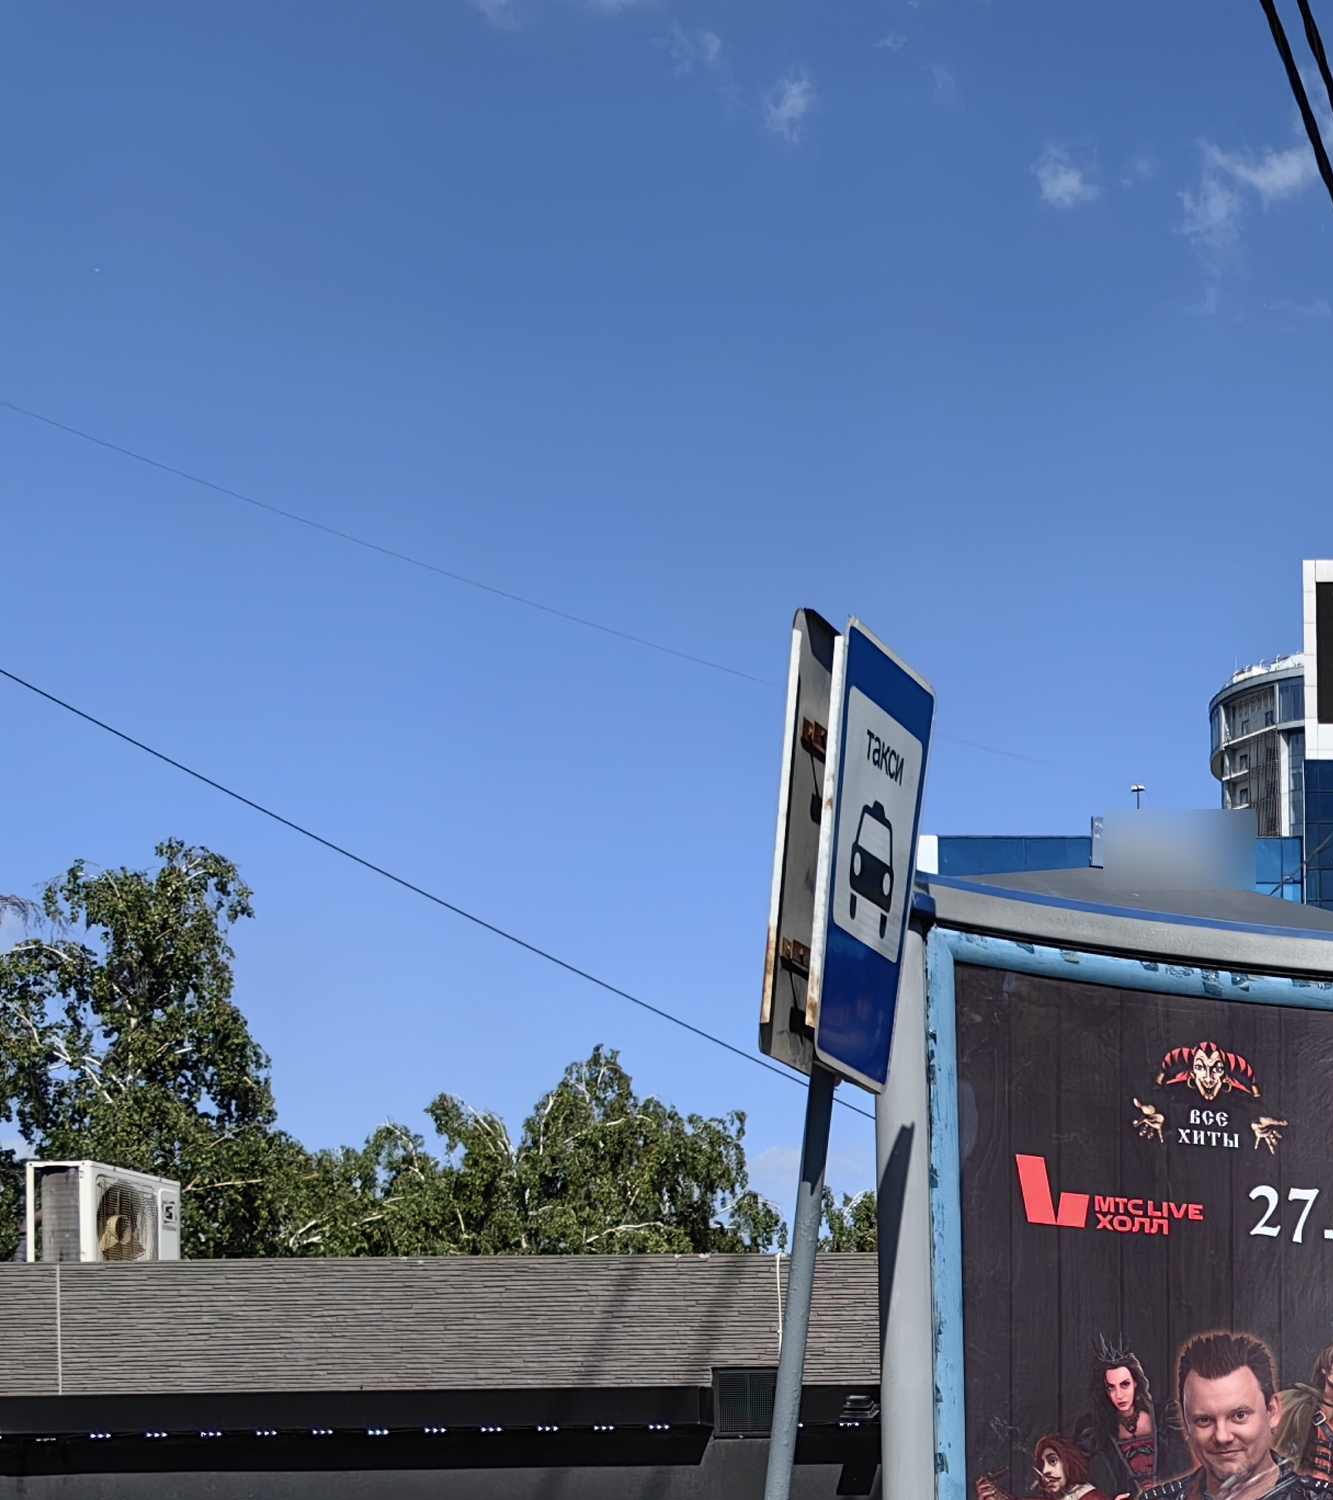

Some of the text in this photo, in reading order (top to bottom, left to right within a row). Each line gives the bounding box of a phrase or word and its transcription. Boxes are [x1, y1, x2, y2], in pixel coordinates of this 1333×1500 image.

[866, 728, 905, 787] такси
[1188, 1108, 1230, 1128] ВСЕ
[1178, 1128, 1240, 1149] ХИТЫ
[1095, 1213, 1169, 1236] ХОЛЛ
